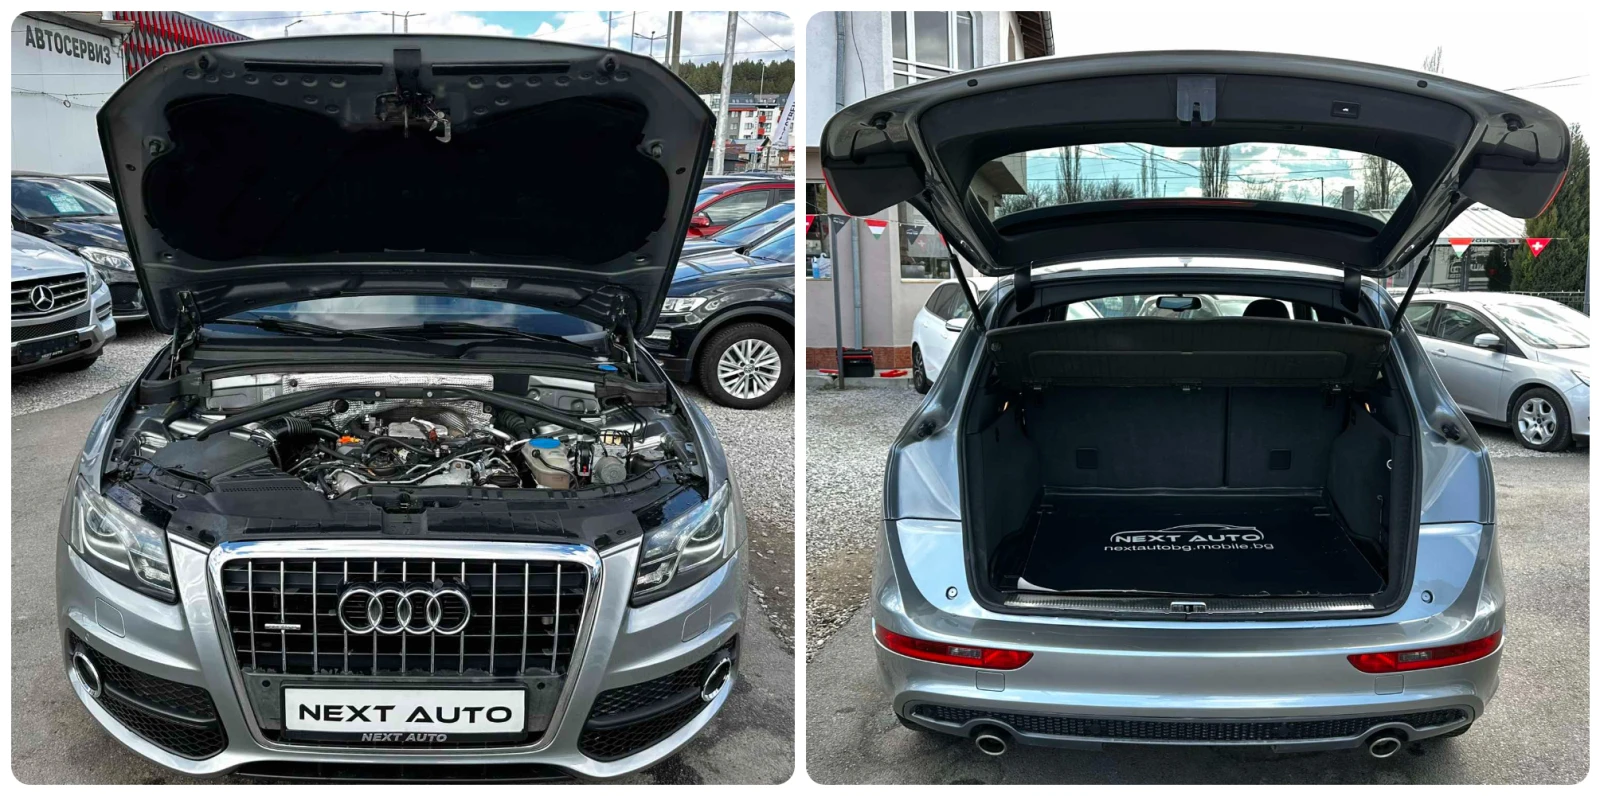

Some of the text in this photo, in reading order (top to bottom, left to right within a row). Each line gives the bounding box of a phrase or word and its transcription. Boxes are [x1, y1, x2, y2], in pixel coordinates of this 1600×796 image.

[26, 25, 111, 65] АВТОСЕРВИЗ
[1188, 534, 1261, 542] AUTO
[1104, 543, 1274, 551] nextautobg.mobile.bg
[299, 704, 513, 723] NEXT AUTO
[361, 733, 448, 742] NEXT AUTO
